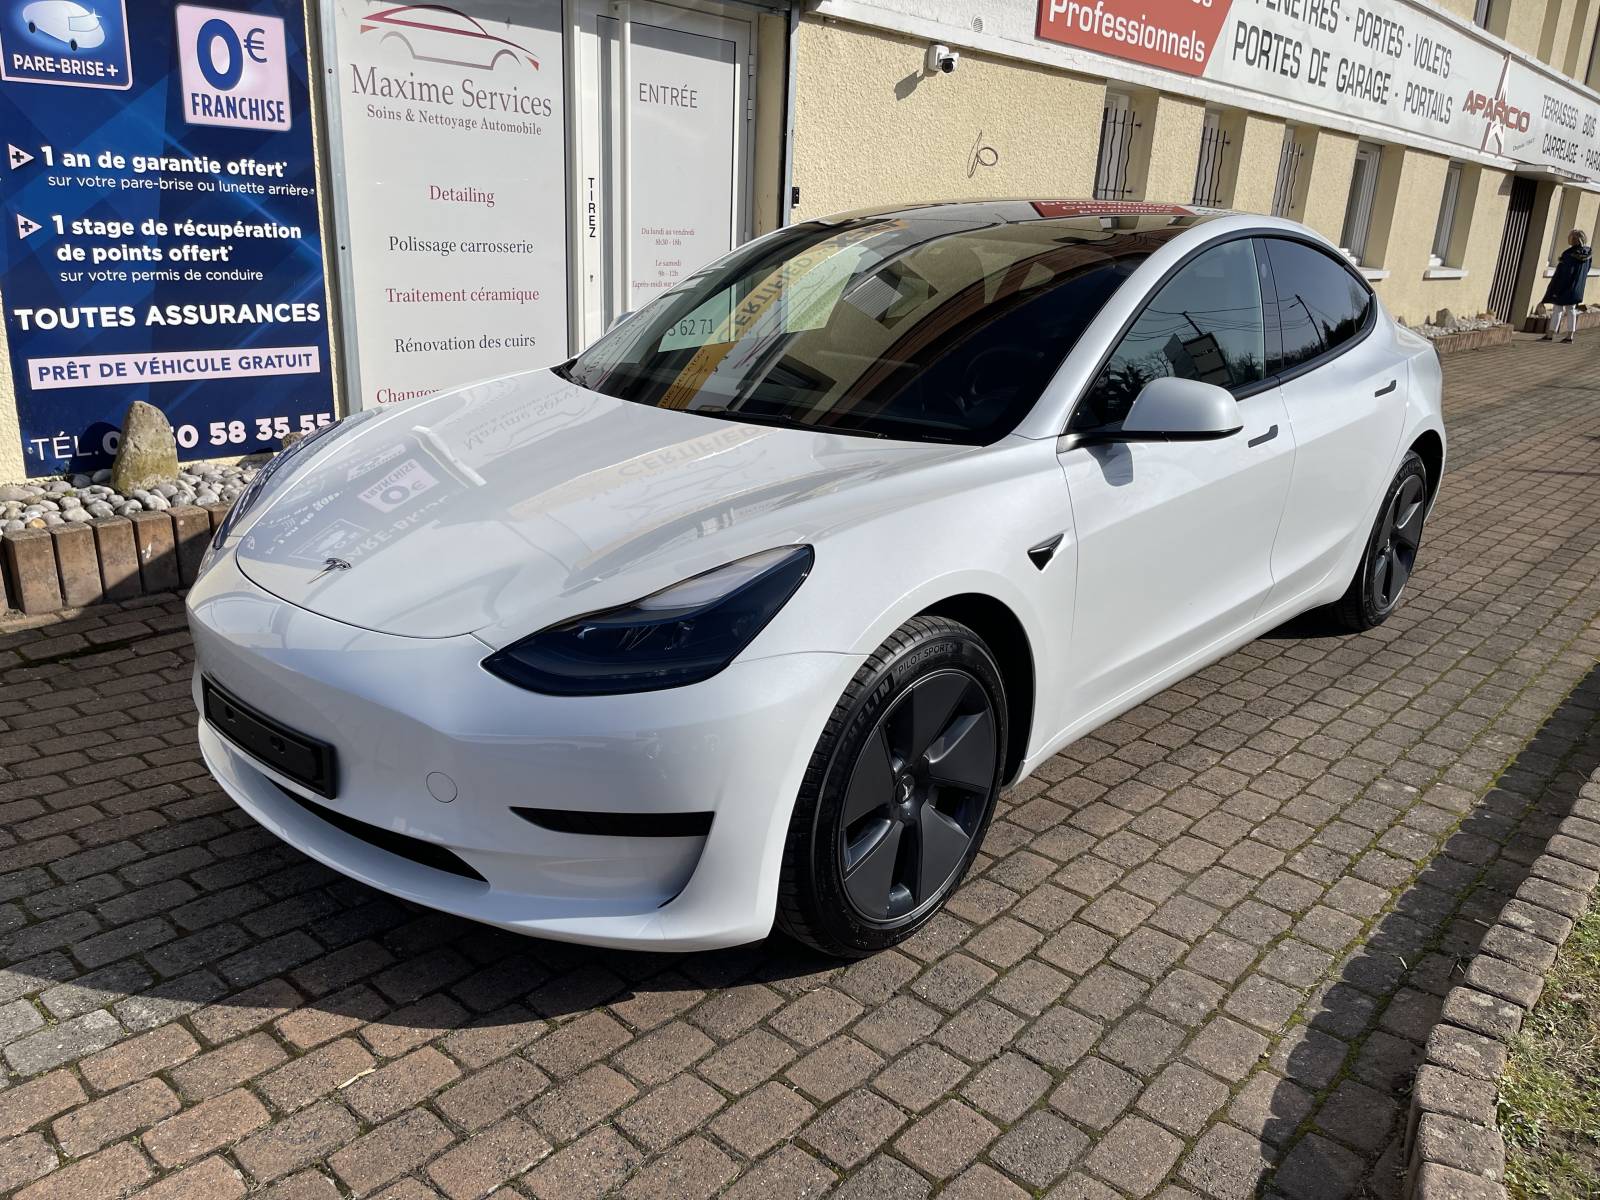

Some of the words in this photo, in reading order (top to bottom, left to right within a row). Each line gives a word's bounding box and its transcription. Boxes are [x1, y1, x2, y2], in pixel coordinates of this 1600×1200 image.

[1049, 0, 1205, 62] Professionnels
[1354, 7, 1404, 59] PORTES
[1413, 33, 1452, 79] VOLETS
[1232, 20, 1302, 79] PORTES
[1307, 47, 1331, 88] DE
[1336, 58, 1391, 105] GARAGE
[1404, 81, 1453, 124] PORTAILS
[350, 63, 454, 105] Maxime
[462, 78, 552, 118] Services
[639, 82, 698, 109] ENTRÉE
[191, 92, 286, 123] FRANCHISE
[367, 104, 402, 121] Soins
[405, 108, 415, 122] &
[418, 110, 478, 131] Nettoyage
[480, 117, 542, 136] Automobile
[1462, 90, 1530, 133] APARICIO
[1541, 94, 1579, 130] TERRASSES
[1582, 113, 1597, 138] BOIS
[41, 145, 54, 167] 1
[63, 154, 91, 168] an
[98, 150, 126, 169] de
[132, 154, 221, 174] garantie
[1541, 133, 1579, 163] CARRELAGE
[48, 176, 72, 187] sur
[76, 176, 116, 188] votre
[121, 178, 194, 196] pare-brise
[198, 181, 215, 192] ou
[219, 180, 265, 194] lunette
[430, 185, 495, 208] Detailing
[587, 177, 596, 238] TIREZ
[52, 215, 65, 235] 1
[72, 218, 135, 239] stage
[140, 218, 168, 236] de
[174, 219, 302, 242] récupération
[57, 244, 85, 261] de
[93, 245, 163, 265] points
[389, 235, 457, 257] Polissage
[460, 240, 534, 254] carrosserie
[61, 270, 84, 282] sur
[88, 270, 127, 282] votre
[132, 269, 181, 283] permis
[184, 269, 202, 281] de
[206, 269, 263, 281] conduire
[386, 287, 467, 303] Traitement
[470, 286, 540, 304] céramique
[14, 306, 137, 331] TOUTES
[145, 303, 321, 326] ASSURANCES
[679, 319, 696, 336] 62
[700, 319, 714, 335] 71
[394, 336, 475, 353] Rénovation
[479, 335, 501, 349] des
[504, 333, 536, 348] cuirs
[38, 360, 91, 382] PRÊT
[100, 363, 127, 377] DE
[134, 356, 231, 376] VÉHICULE
[238, 353, 312, 370] GRATUIT
[30, 432, 99, 461] TÉL.
[170, 423, 199, 449] 0
[209, 420, 247, 446] 58
[256, 417, 291, 441] 35
[898, 652, 921, 672] PILOT
[924, 644, 949, 658] SPORT
